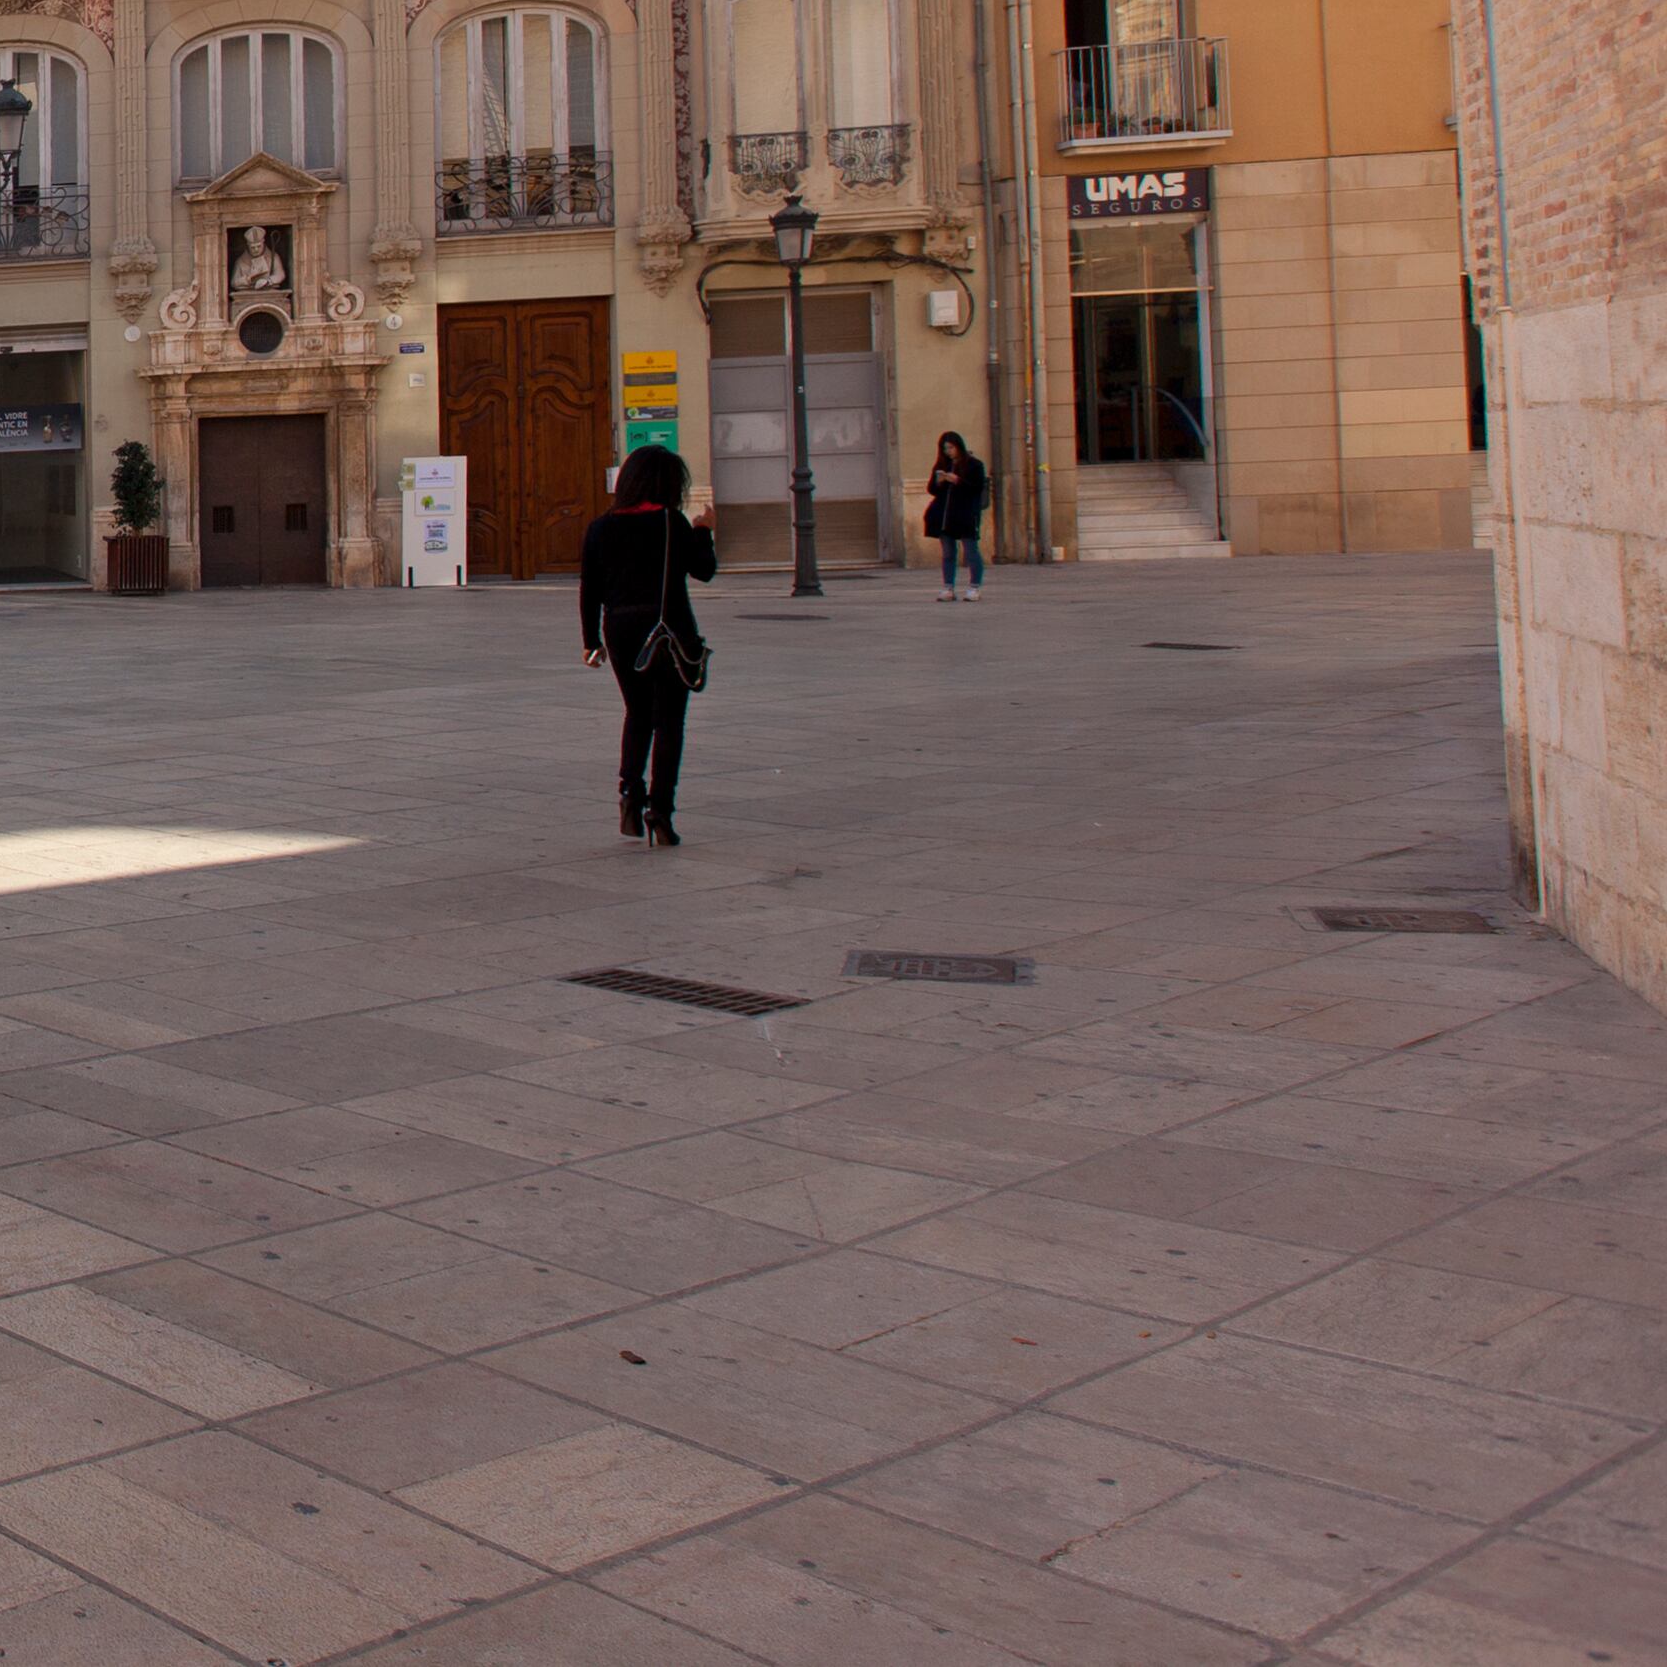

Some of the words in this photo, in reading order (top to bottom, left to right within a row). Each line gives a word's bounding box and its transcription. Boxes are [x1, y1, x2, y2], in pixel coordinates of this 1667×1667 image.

[1085, 172, 1186, 201] UMAS
[1072, 197, 1202, 215] SEGUROS
[4, 412, 27, 420] VIDRE
[17, 420, 28, 428] EN
